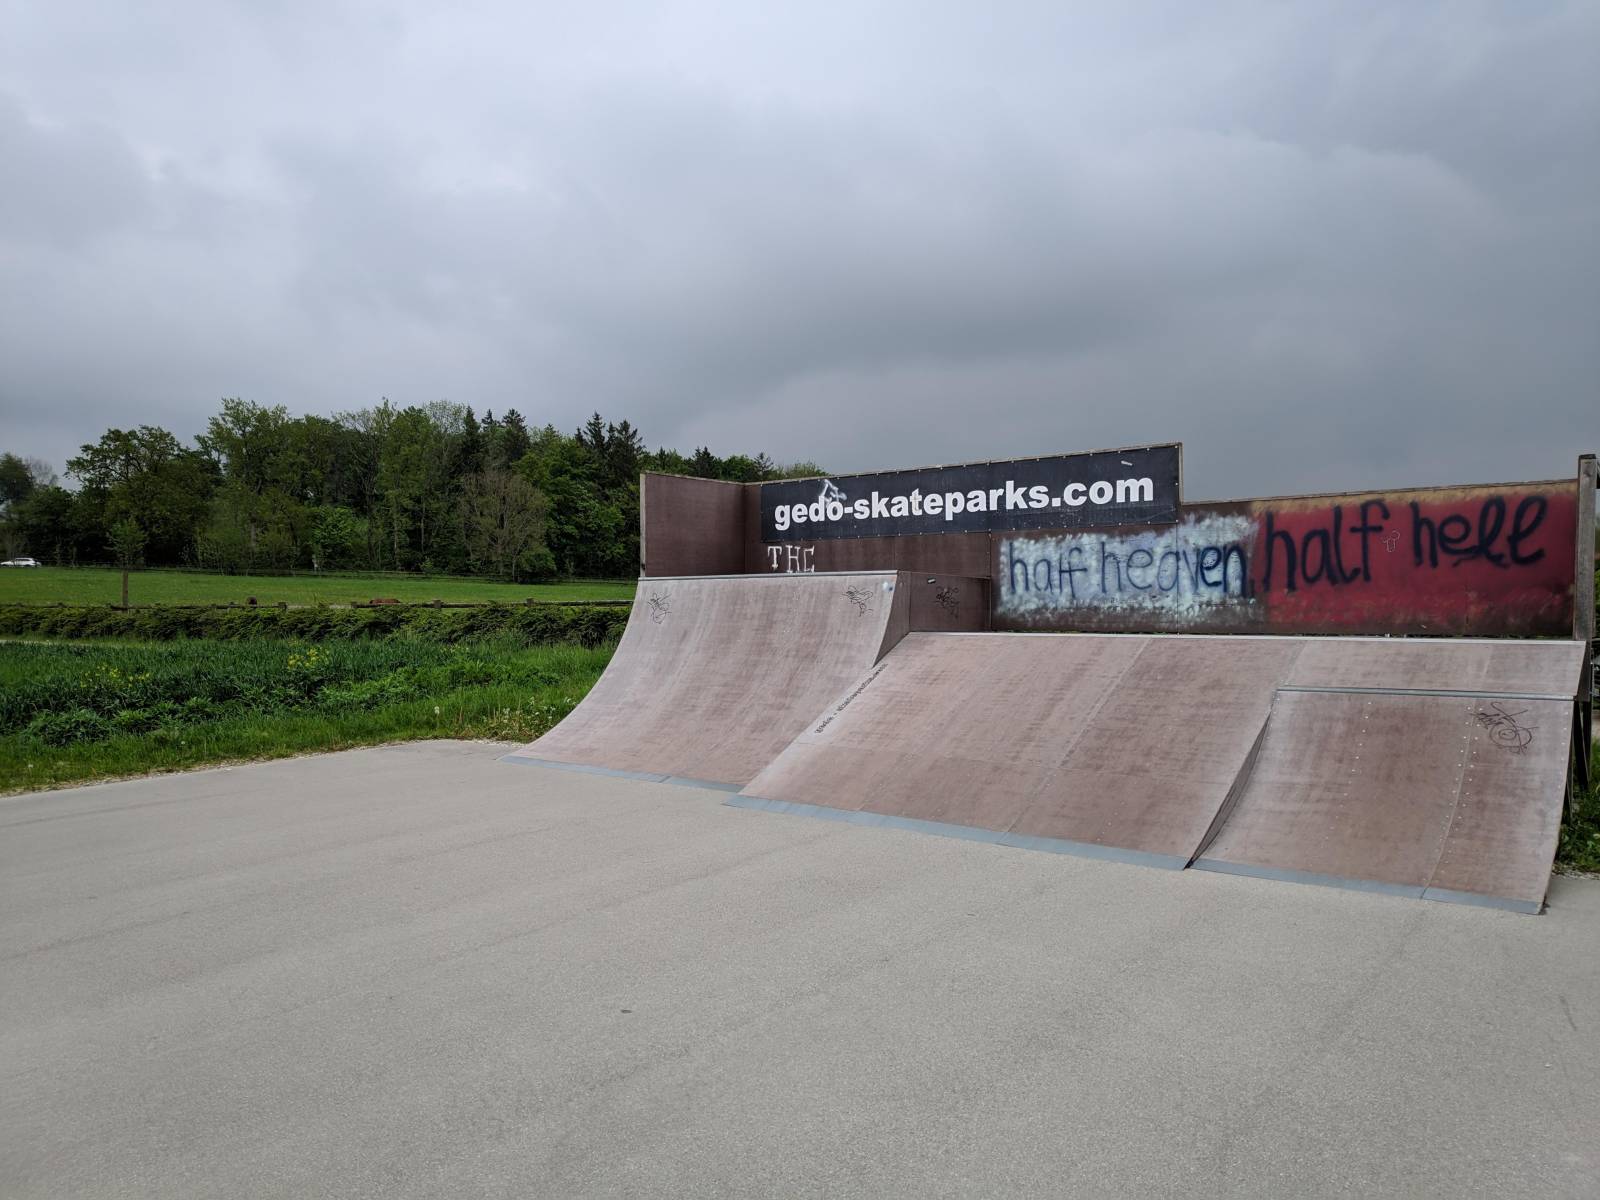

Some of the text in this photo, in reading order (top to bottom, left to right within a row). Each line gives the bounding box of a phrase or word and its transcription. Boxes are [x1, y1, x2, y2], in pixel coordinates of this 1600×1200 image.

[774, 477, 1154, 531] gedo-skateparks.com
[767, 544, 815, 574] THC
[1101, 541, 1248, 599] heaven
[1263, 499, 1391, 594] half
[1409, 495, 1547, 569] hell
